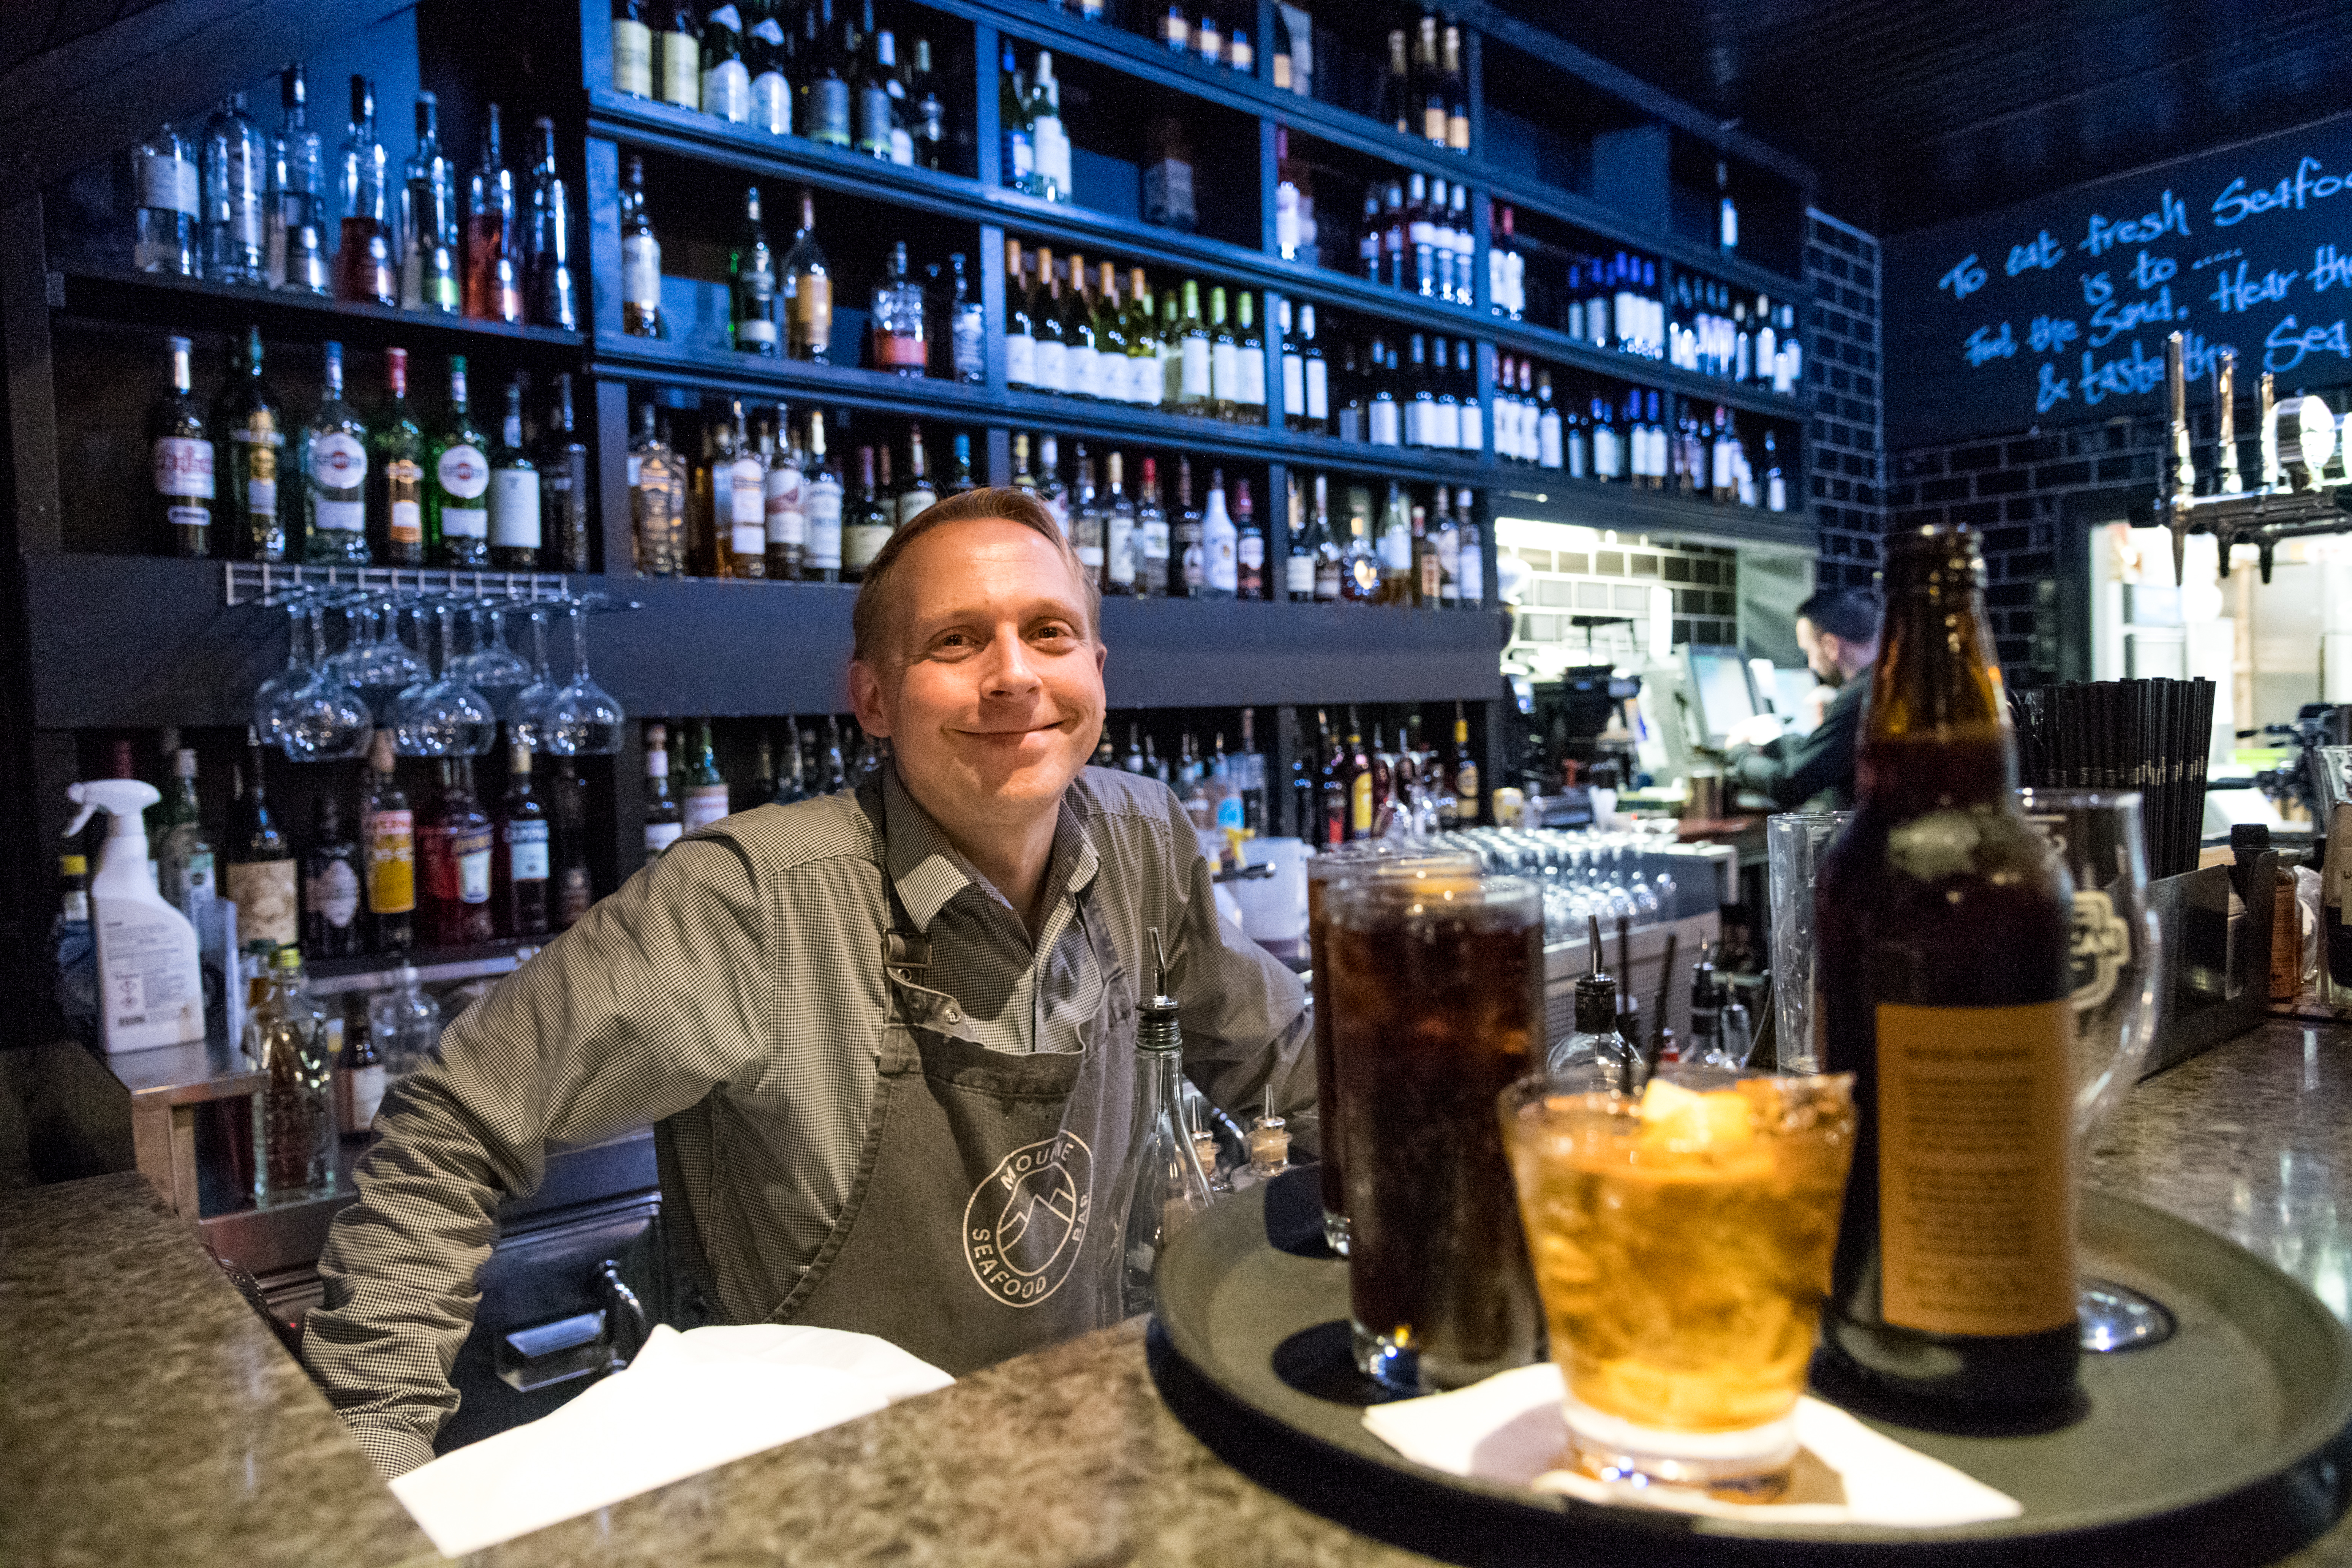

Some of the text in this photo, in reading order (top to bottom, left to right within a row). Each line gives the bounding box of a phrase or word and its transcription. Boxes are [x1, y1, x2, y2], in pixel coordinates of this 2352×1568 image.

[2079, 189, 2191, 255] fresh
[2129, 249, 2177, 289] to
[2209, 260, 2299, 311] Hear
[2306, 245, 2352, 292] th
[972, 1228, 1046, 1299] SEAFOOD
